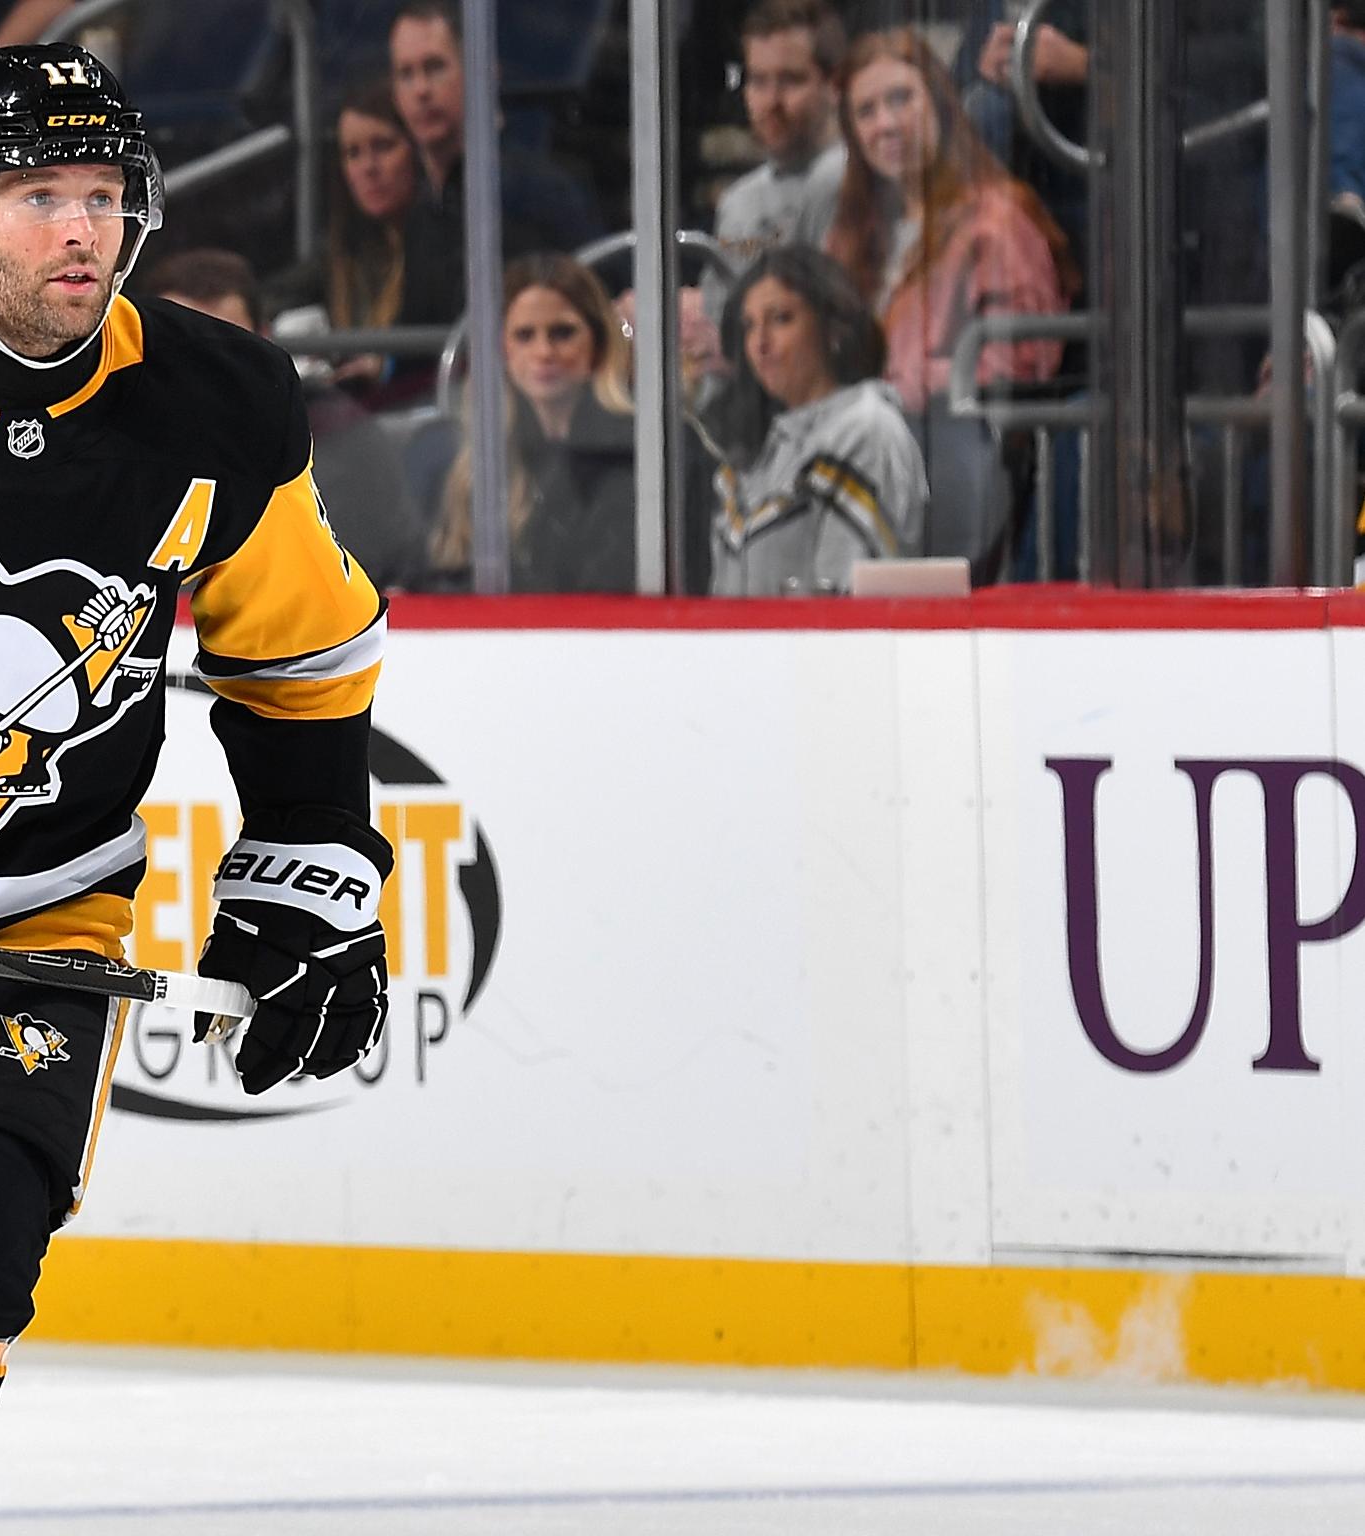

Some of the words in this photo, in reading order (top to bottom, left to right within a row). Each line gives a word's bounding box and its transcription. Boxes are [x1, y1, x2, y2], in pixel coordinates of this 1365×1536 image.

[40, 59, 90, 85] 17
[47, 114, 107, 126] CCM
[16, 429, 37, 450] NHL
[146, 477, 217, 572] A
[219, 852, 371, 911] AUER
[1045, 758, 1365, 1073] UP
[156, 974, 169, 1000] HTR
